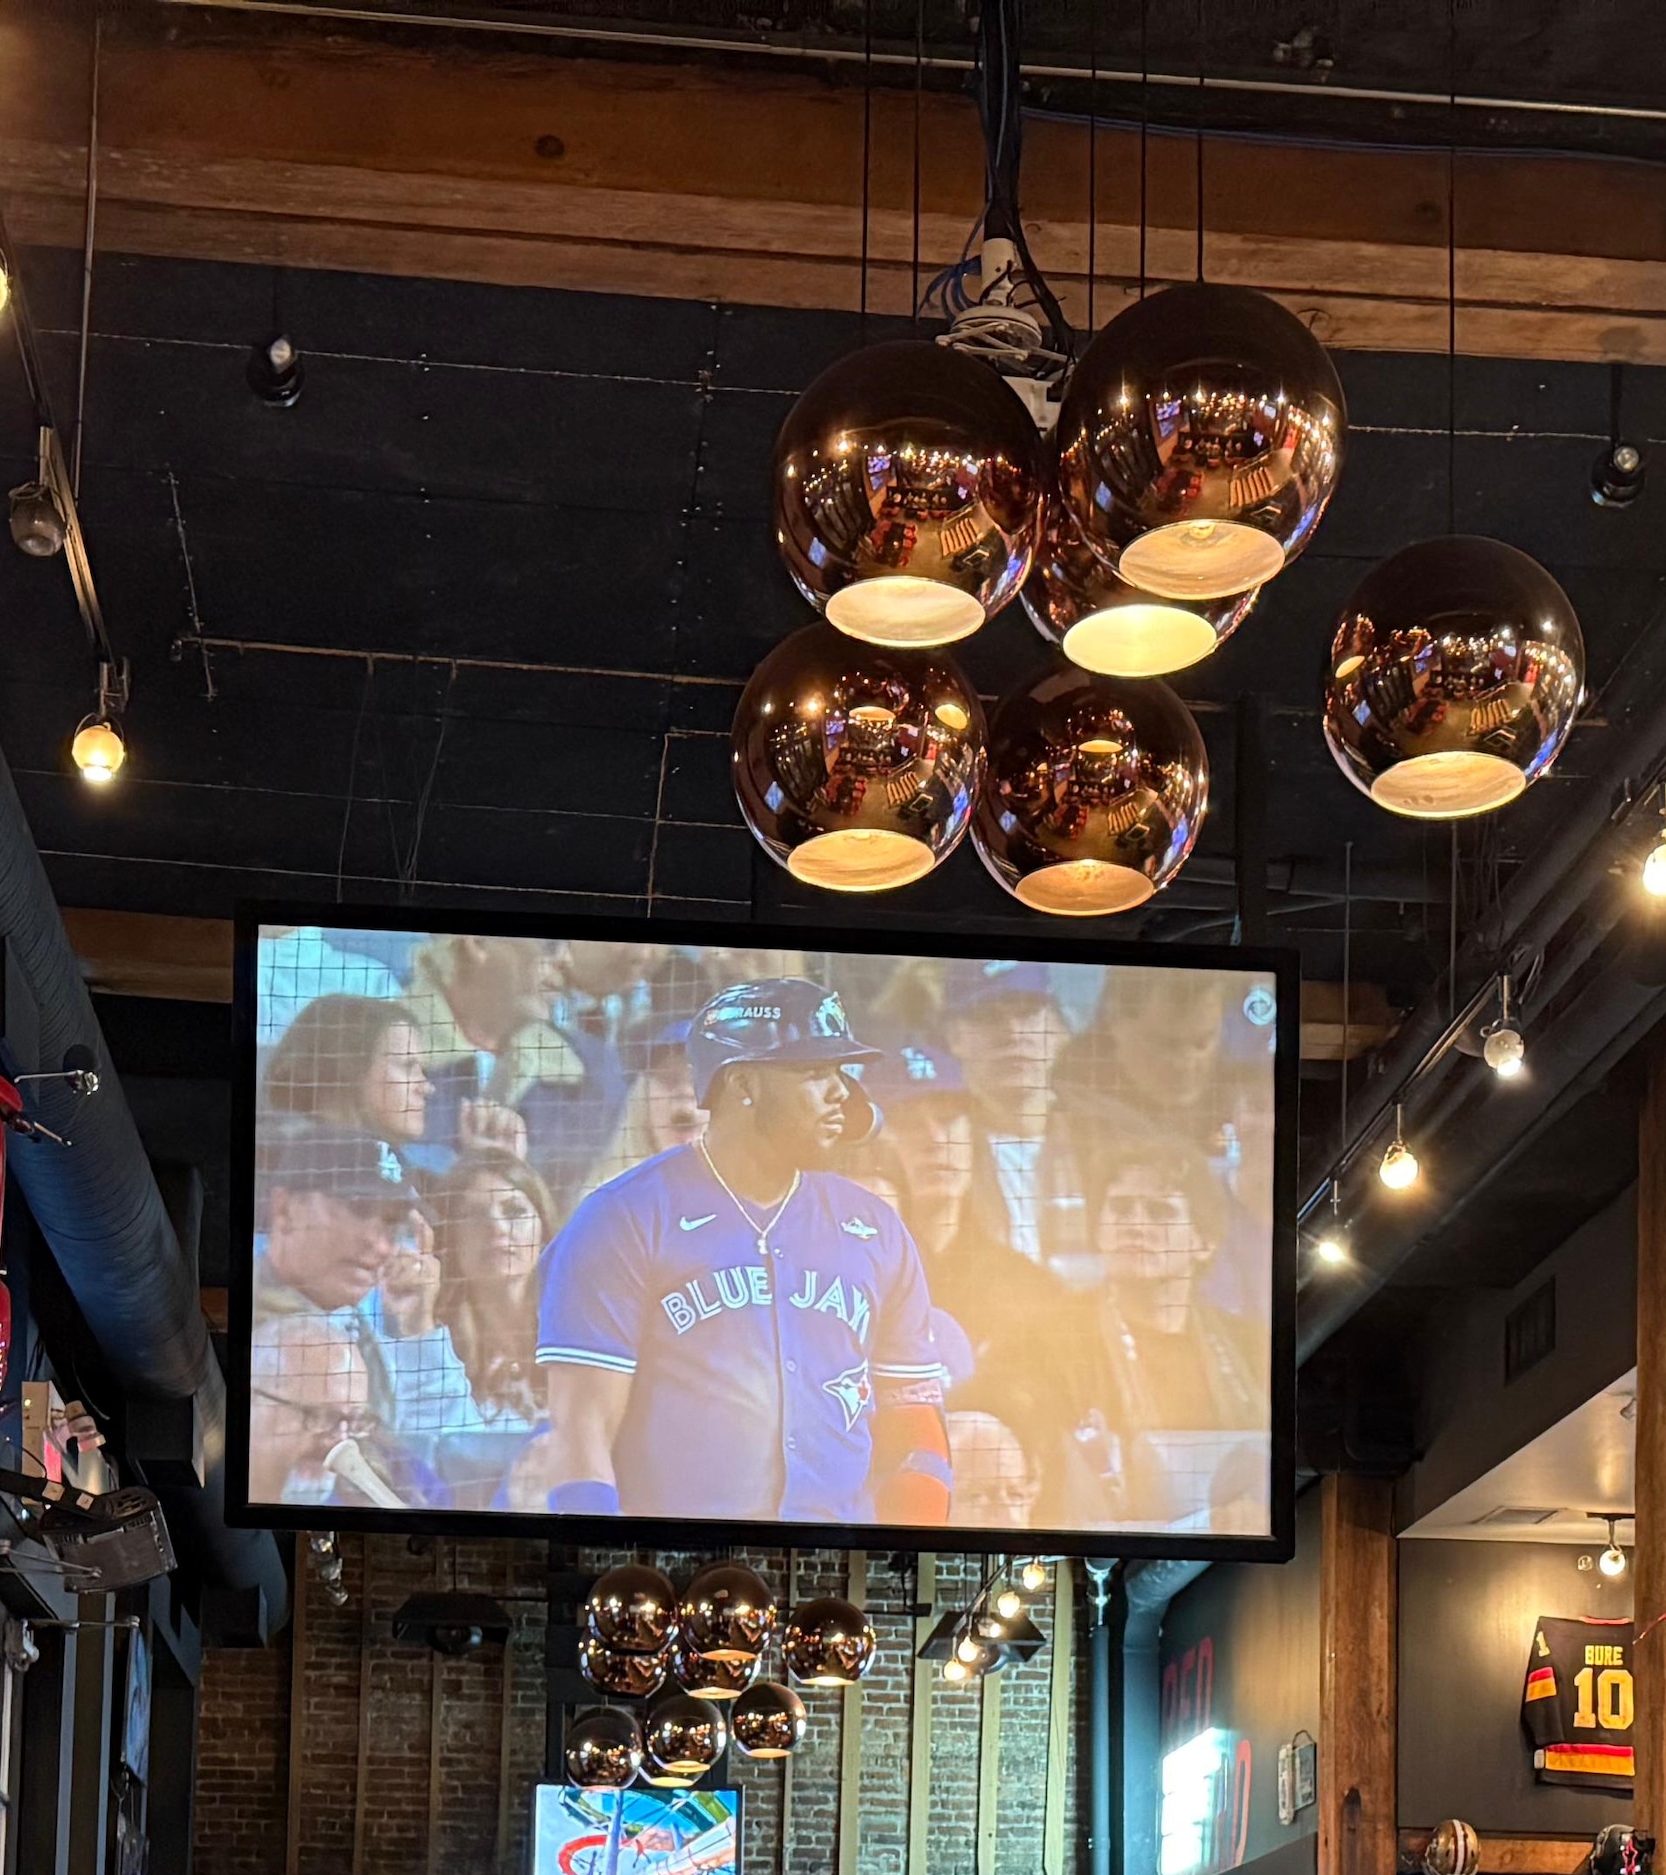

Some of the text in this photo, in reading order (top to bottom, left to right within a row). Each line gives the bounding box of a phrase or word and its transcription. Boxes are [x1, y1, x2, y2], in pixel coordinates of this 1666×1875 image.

[661, 1266, 773, 1335] BLUE
[1585, 1645, 1624, 1666] BURE
[1573, 1667, 1634, 1730] 10
